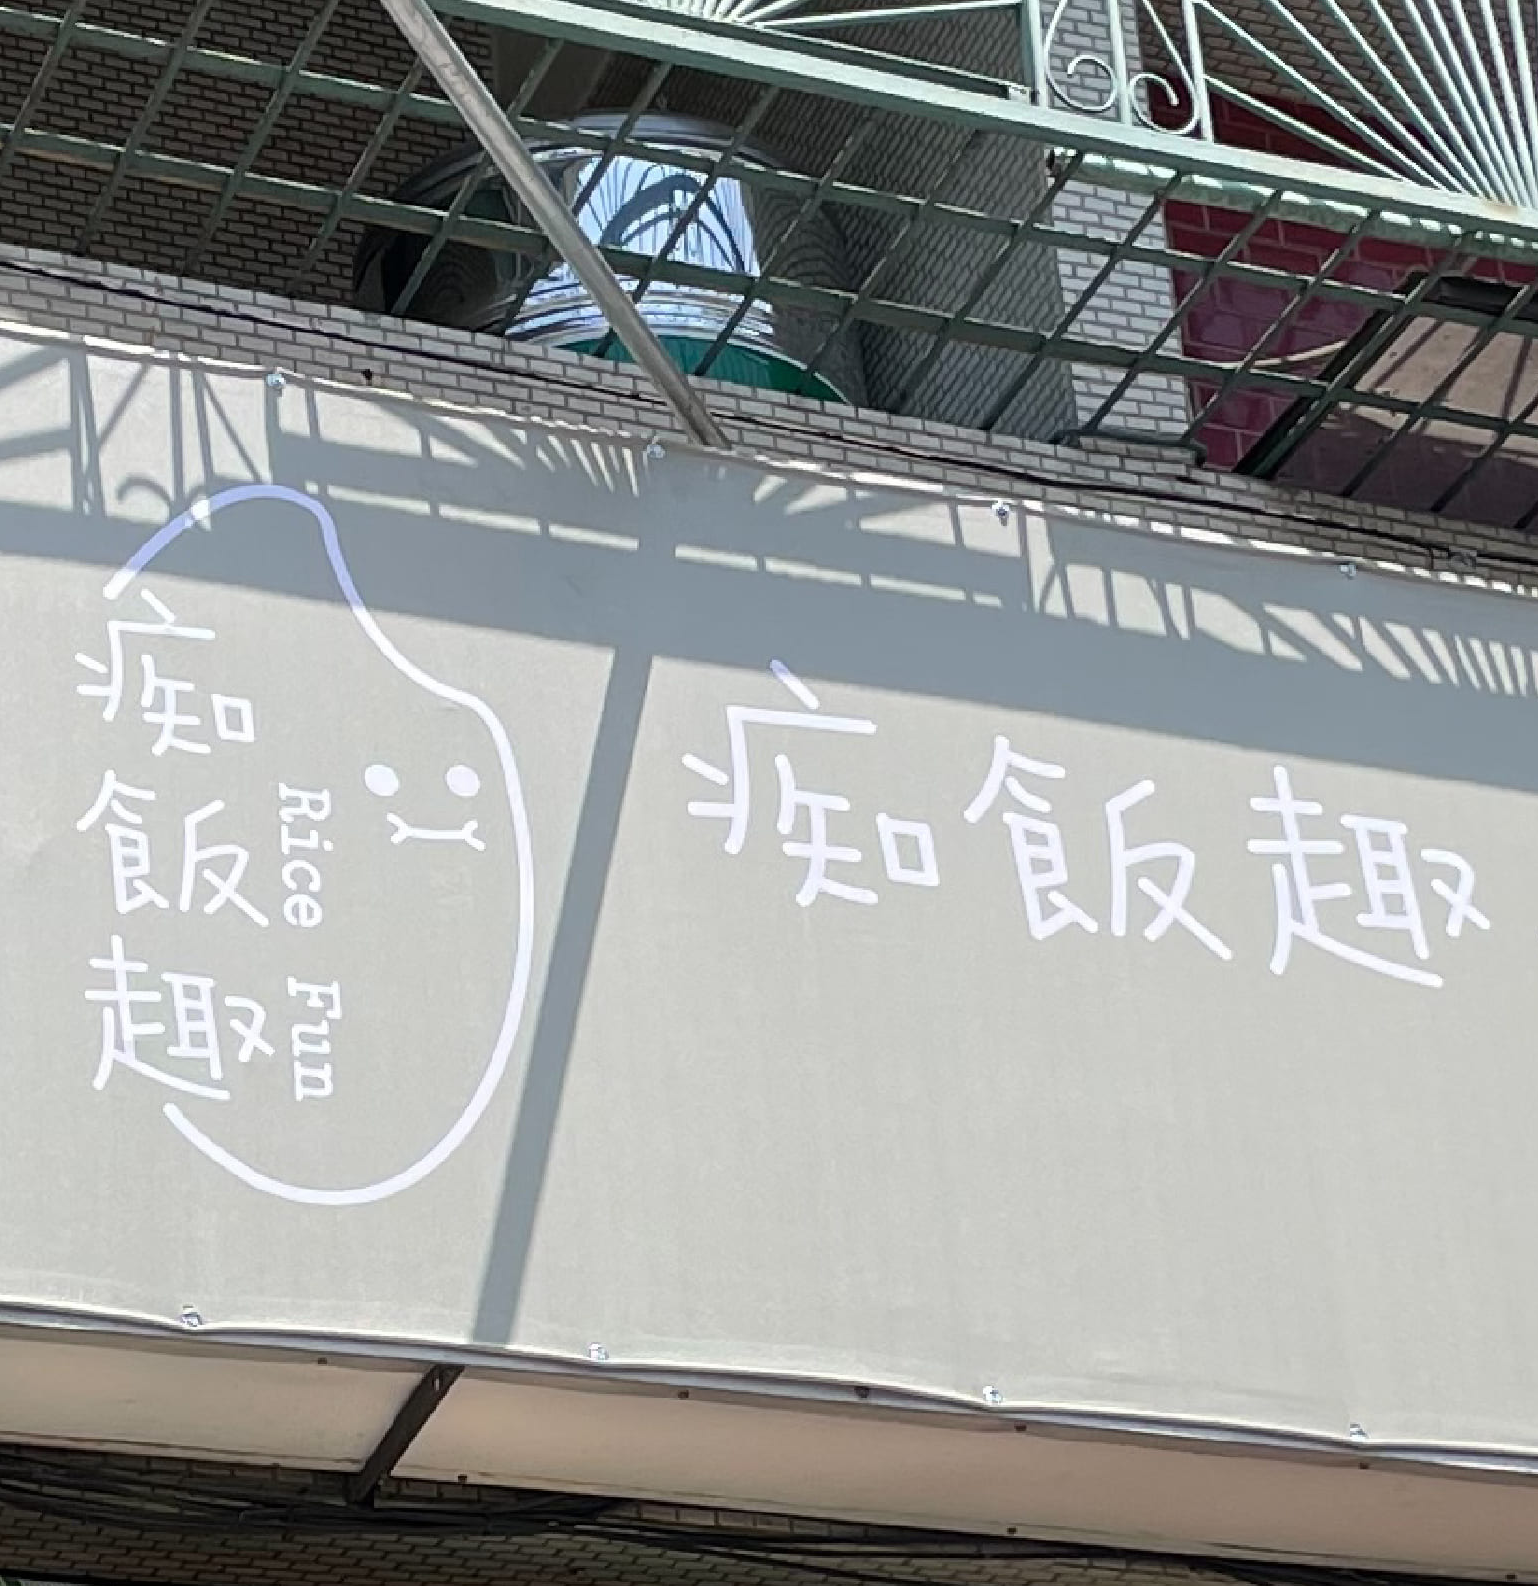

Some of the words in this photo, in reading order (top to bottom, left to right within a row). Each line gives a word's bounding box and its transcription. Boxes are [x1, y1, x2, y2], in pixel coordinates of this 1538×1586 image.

[277, 781, 334, 929] Rice
[680, 659, 1492, 989] 痴飯趣
[286, 974, 344, 1102] Fun
